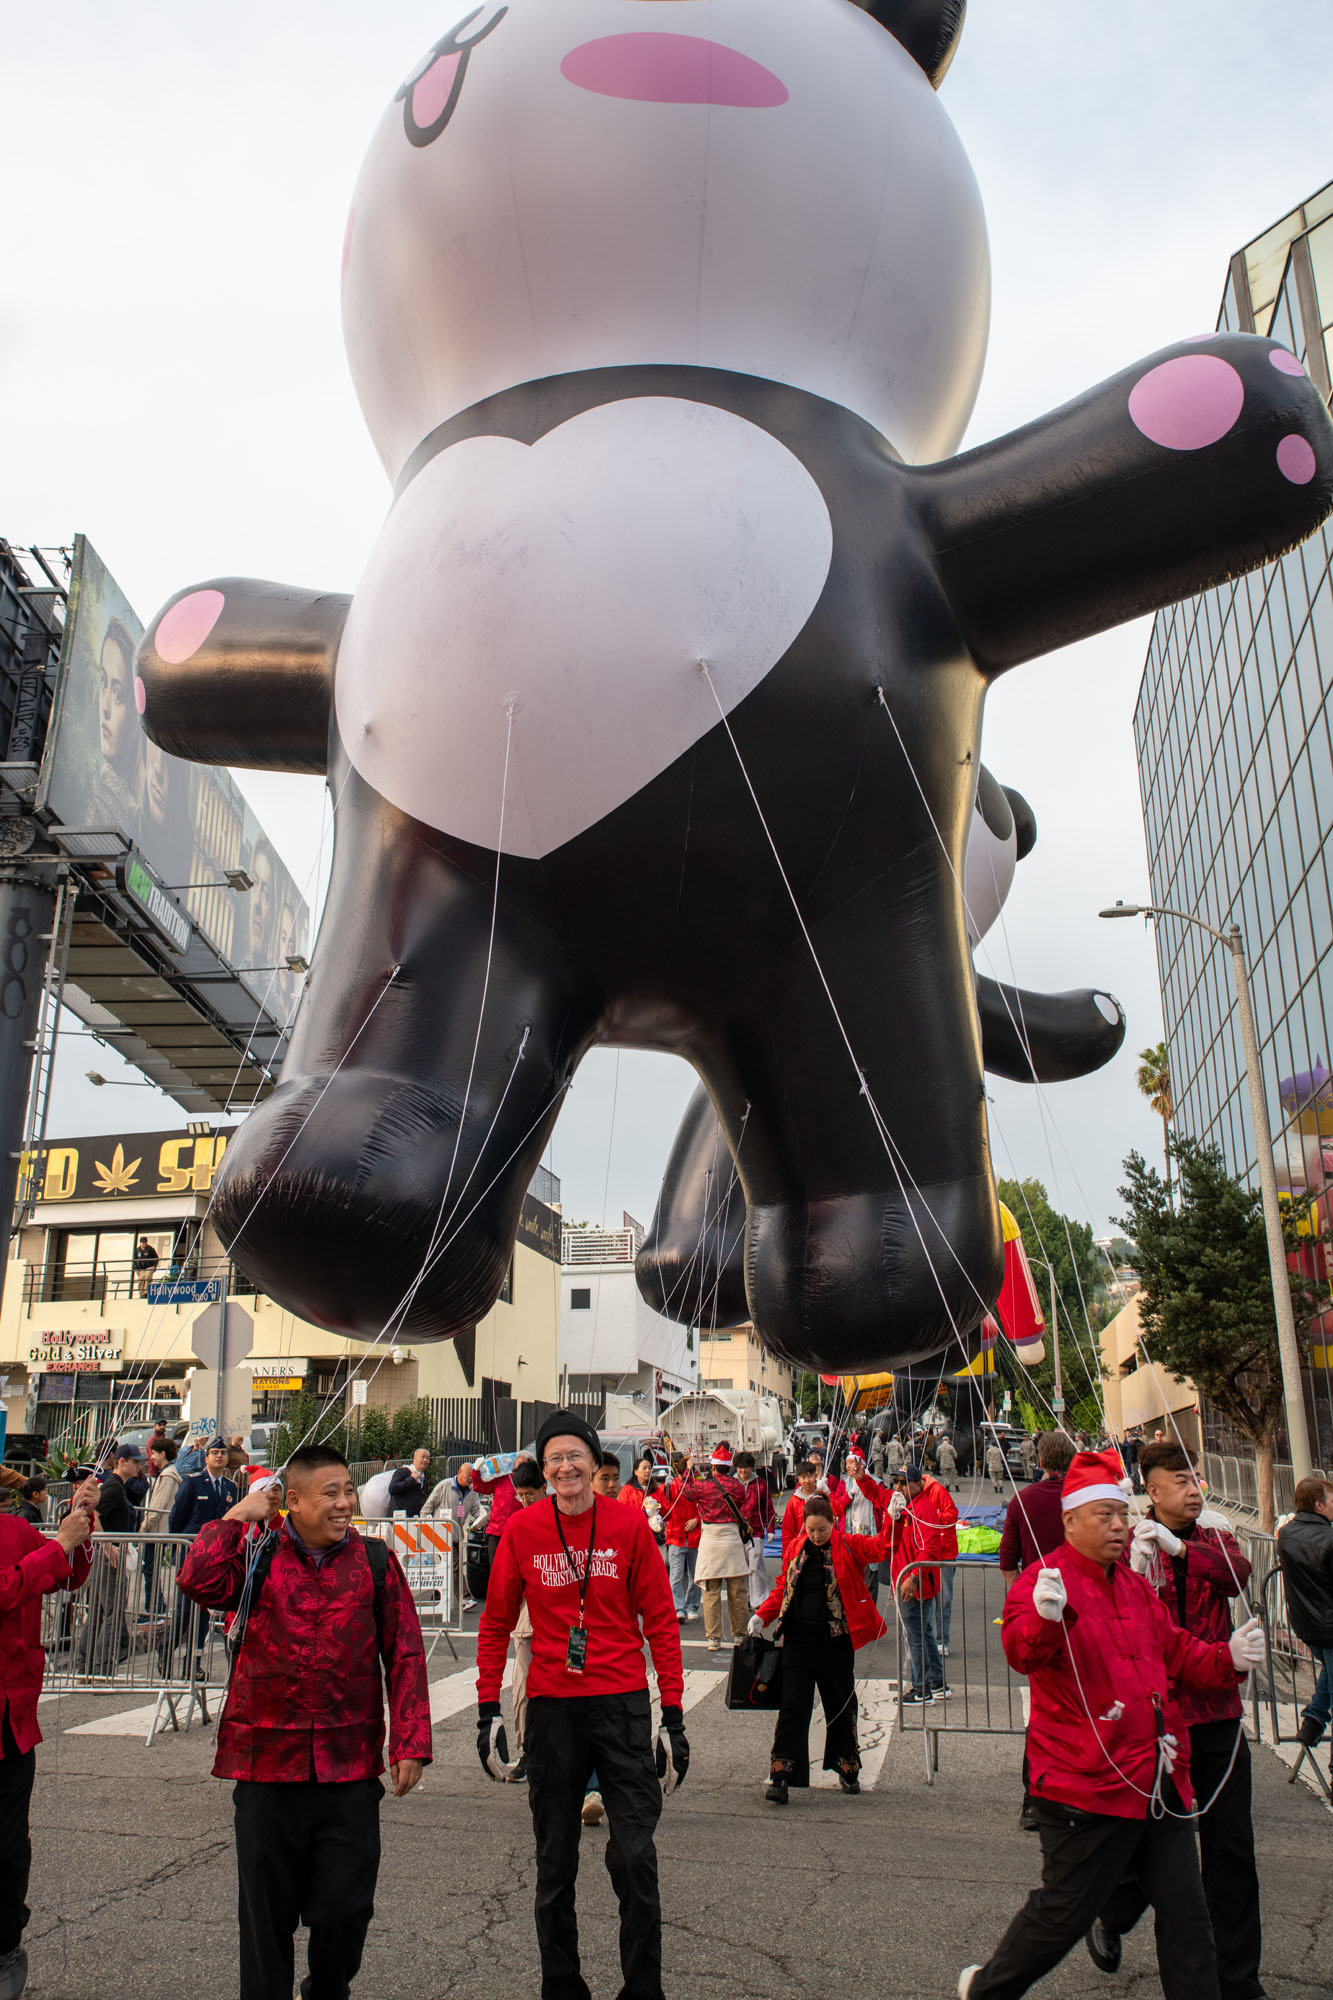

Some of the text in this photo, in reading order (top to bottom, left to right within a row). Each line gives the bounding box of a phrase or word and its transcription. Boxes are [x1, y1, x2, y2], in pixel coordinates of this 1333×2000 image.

[150, 1281, 218, 1298] Hollywood Bl
[210, 1292, 217, 1301] W
[41, 1329, 111, 1347] Hollywood
[29, 1345, 122, 1361] Gold & Silver
[46, 1361, 101, 1372] EXCHANGE
[533, 1550, 585, 1572] HOLLYWOOD
[541, 1564, 586, 1587] CHRISTMAS
